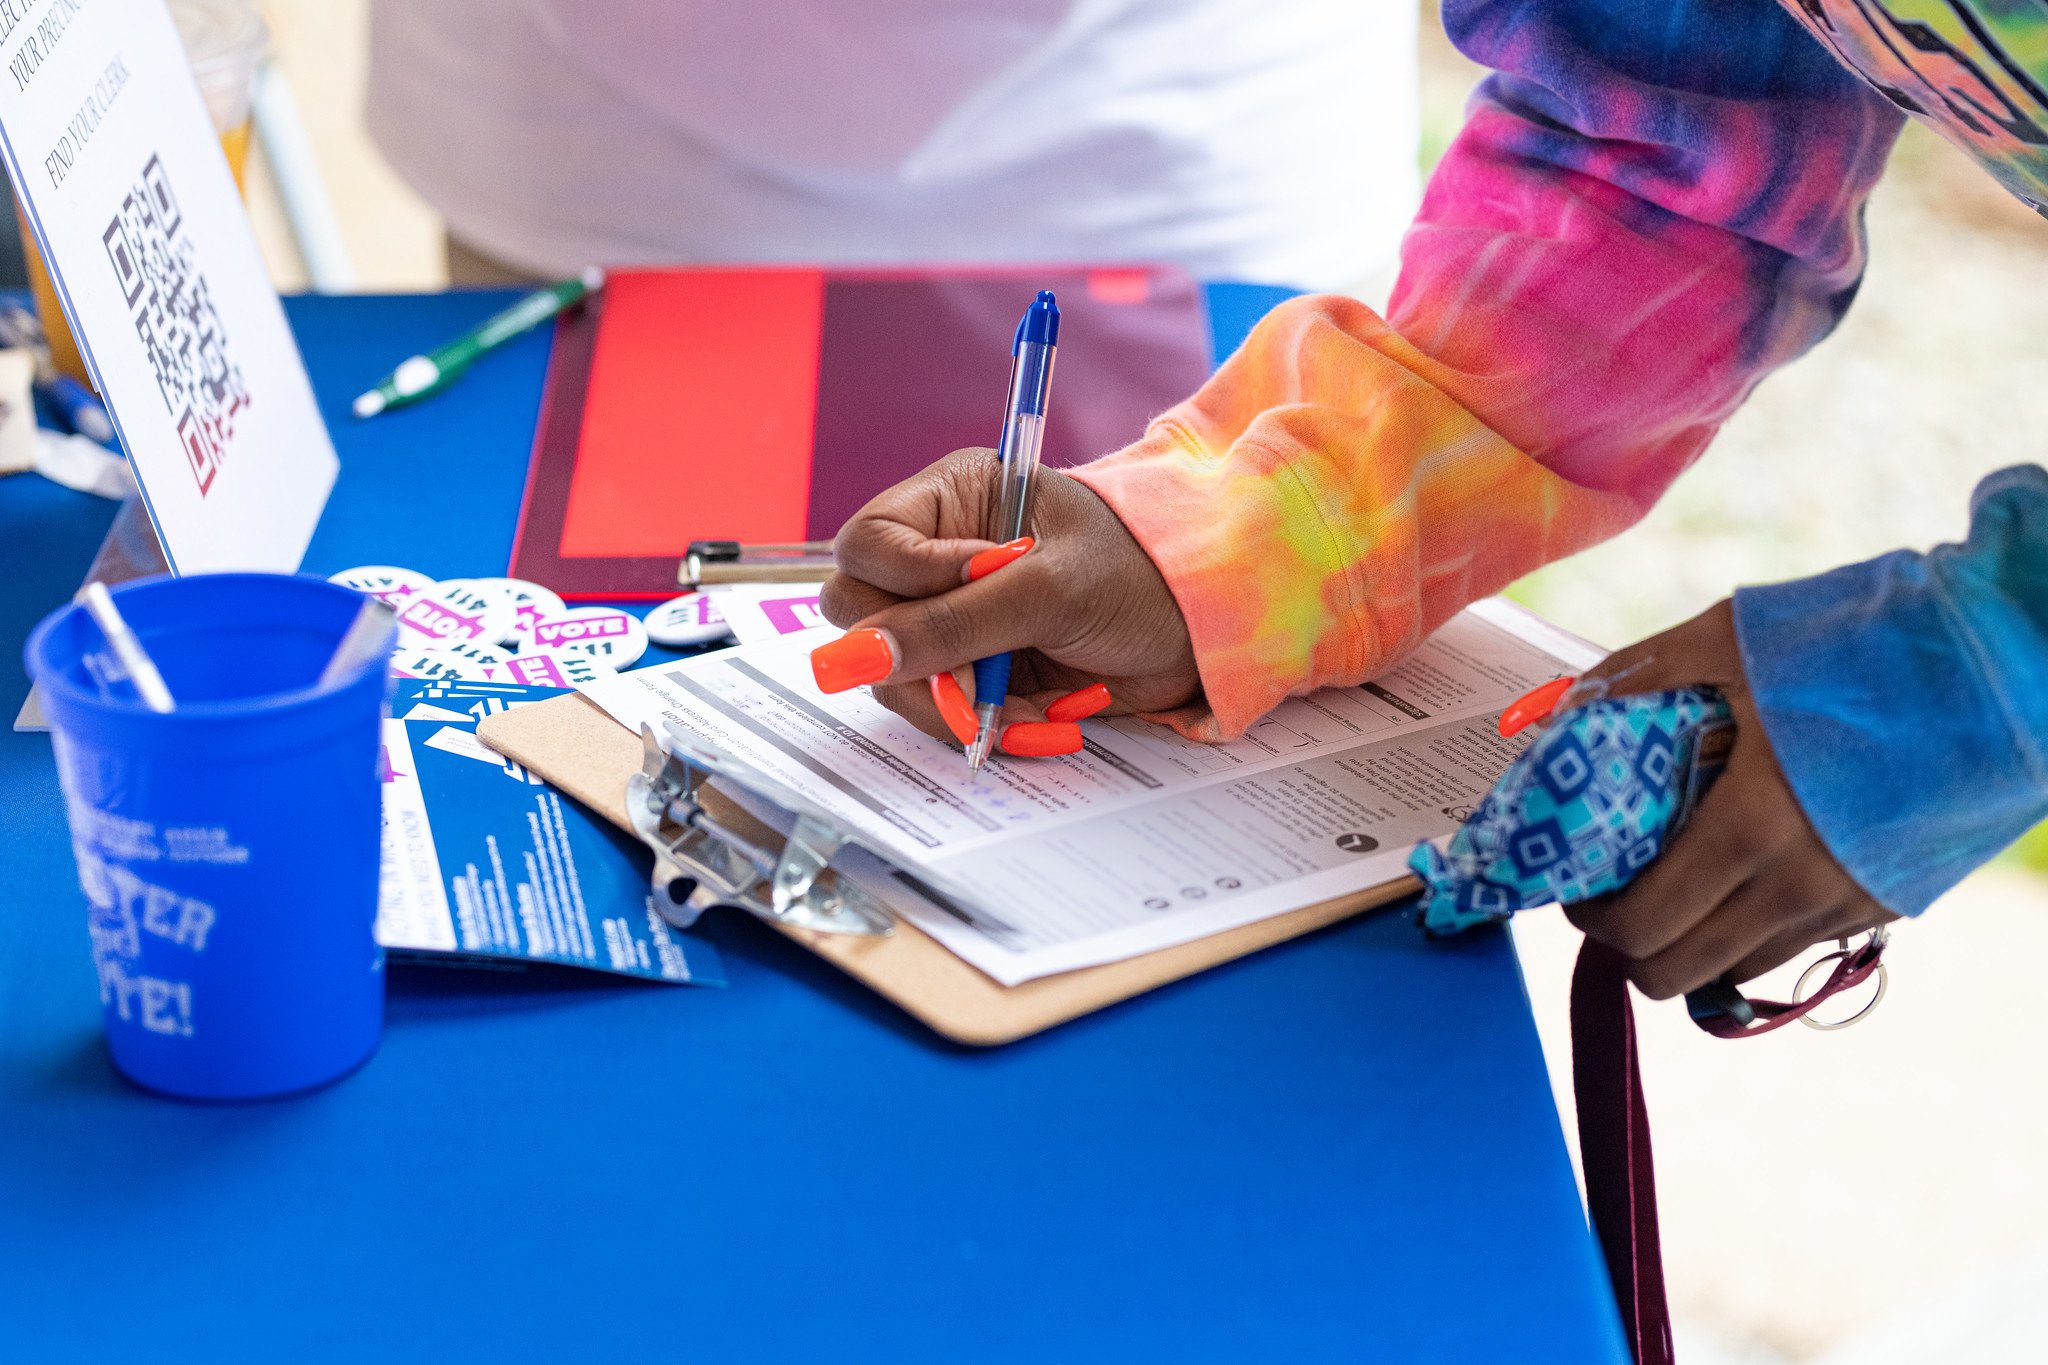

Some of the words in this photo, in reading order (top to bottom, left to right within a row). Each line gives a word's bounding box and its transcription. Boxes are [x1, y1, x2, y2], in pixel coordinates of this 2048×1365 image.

[9, 36, 44, 92] YOUR
[44, 136, 74, 190] FIND
[68, 96, 102, 151] YOUR
[538, 619, 627, 641] VOTE
[517, 657, 556, 687] OTE
[631, 676, 659, 690] Form
[650, 688, 688, 708] Change
[1379, 692, 1427, 716] signature
[780, 703, 798, 712] this
[1319, 707, 1345, 720] address
[677, 707, 714, 727] Address
[792, 711, 827, 730] complete
[1387, 714, 1403, 722] city
[705, 725, 731, 738] Card
[1340, 719, 1366, 732] mailing
[820, 729, 841, 739] NOT
[1299, 731, 1322, 743] phone
[1444, 736, 1463, 745] the
[1456, 733, 1481, 745] voter
[1478, 726, 1510, 742] change
[849, 734, 891, 758] personal
[1254, 740, 1281, 754] address
[1392, 745, 1418, 758] clerk.
[1440, 743, 1477, 762] personal
[1458, 743, 1493, 761] requires
[1474, 744, 1493, 753] for
[1226, 755, 1245, 763] date
[1424, 744, 1464, 764] Michigan
[1487, 751, 1511, 763] used
[1346, 757, 1366, 767] you
[1362, 757, 1379, 765] by
[1377, 756, 1398, 766] and
[1391, 755, 1436, 779] verification
[1486, 760, 1506, 769] law
[1330, 759, 1368, 778] deadline
[1359, 766, 1382, 777] Day,
[1373, 764, 1395, 774] vote
[1391, 765, 1415, 776] form
[1412, 757, 1466, 785] city/township
[1478, 766, 1501, 776] (DL)
[1002, 768, 1028, 783] Social
[1299, 771, 1333, 788] register
[1410, 775, 1429, 784] this
[1243, 779, 1283, 800] delivered
[1276, 779, 1297, 788] and
[1299, 782, 1318, 791] the
[1360, 777, 1392, 792] 15-day
[1375, 776, 1410, 793] Election
[1398, 778, 1432, 795] register
[1430, 777, 1471, 798] residency
[1460, 784, 1482, 794] your
[1230, 783, 1265, 800] election
[1272, 787, 1297, 798] days
[1290, 787, 1311, 796] day
[1311, 789, 1328, 797] all
[1384, 791, 1404, 800] the
[1422, 783, 1459, 801] bringing
[1304, 796, 1339, 813] election
[1322, 796, 1342, 805] met
[1397, 799, 1422, 811] After
[1414, 798, 1434, 807] and
[1426, 794, 1447, 804] may
[1299, 803, 1323, 815] than
[1336, 805, 1360, 816] have
